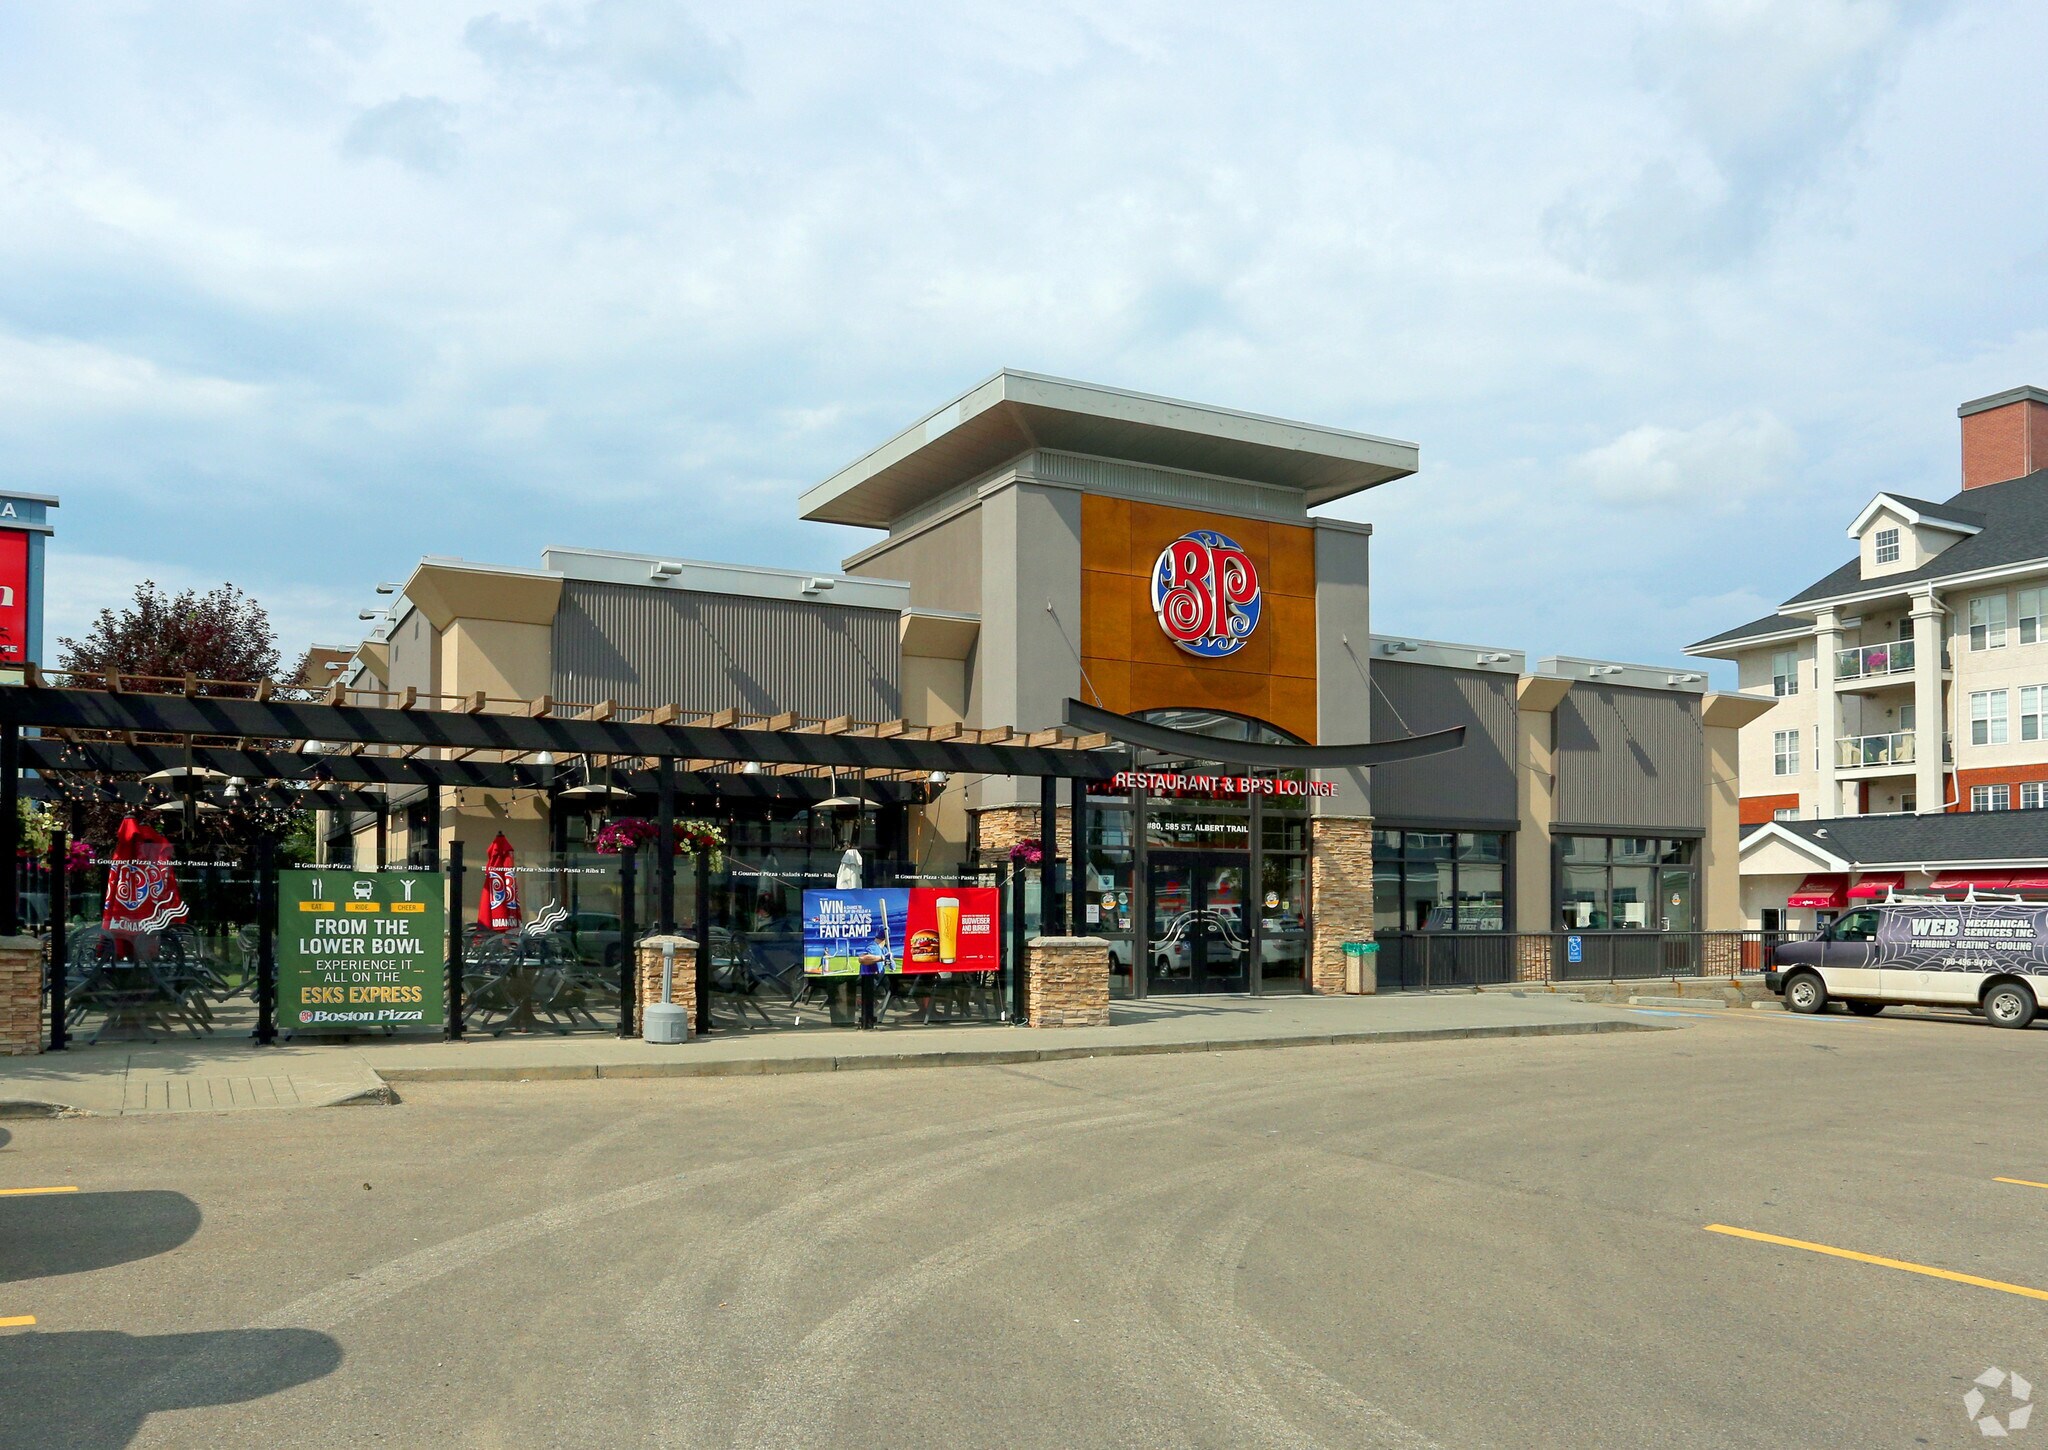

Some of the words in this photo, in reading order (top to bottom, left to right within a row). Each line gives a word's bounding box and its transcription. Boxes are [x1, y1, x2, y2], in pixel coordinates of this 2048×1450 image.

[1158, 539, 1259, 642] BP
[1115, 772, 1219, 792] RESTAURANT
[1225, 777, 1235, 792] &
[1240, 778, 1274, 794] BP'S
[1278, 780, 1340, 797] LOUNGE
[1146, 822, 1163, 831] #80,
[1194, 824, 1225, 832] ALBERT
[820, 900, 843, 914] WIN
[820, 914, 846, 924] BLUE
[847, 914, 872, 924] JAYS
[1965, 920, 2031, 928] MECHANICAL
[315, 919, 367, 934] FROM
[374, 920, 409, 934] THE
[820, 924, 839, 938] FAN
[842, 924, 872, 938] CAMP
[1912, 919, 1960, 936] WEB
[1963, 929, 2013, 937] SERVICES
[2014, 929, 2037, 938] INC.
[300, 938, 365, 954] LOWER
[372, 938, 424, 954] BOWL
[1911, 940, 1950, 948] PLUMBING
[1956, 941, 1989, 949] HEATING
[1996, 942, 2032, 951] COOLING
[316, 960, 396, 970] EXPERIENCE
[402, 960, 413, 970] IT
[324, 972, 348, 982] ALL
[352, 972, 370, 982] ON
[375, 972, 400, 982] THE
[301, 987, 345, 1004] ESKS
[349, 986, 423, 1003] EXPRESS
[314, 1011, 374, 1022] Boston
[378, 1009, 423, 1020] Pizza
